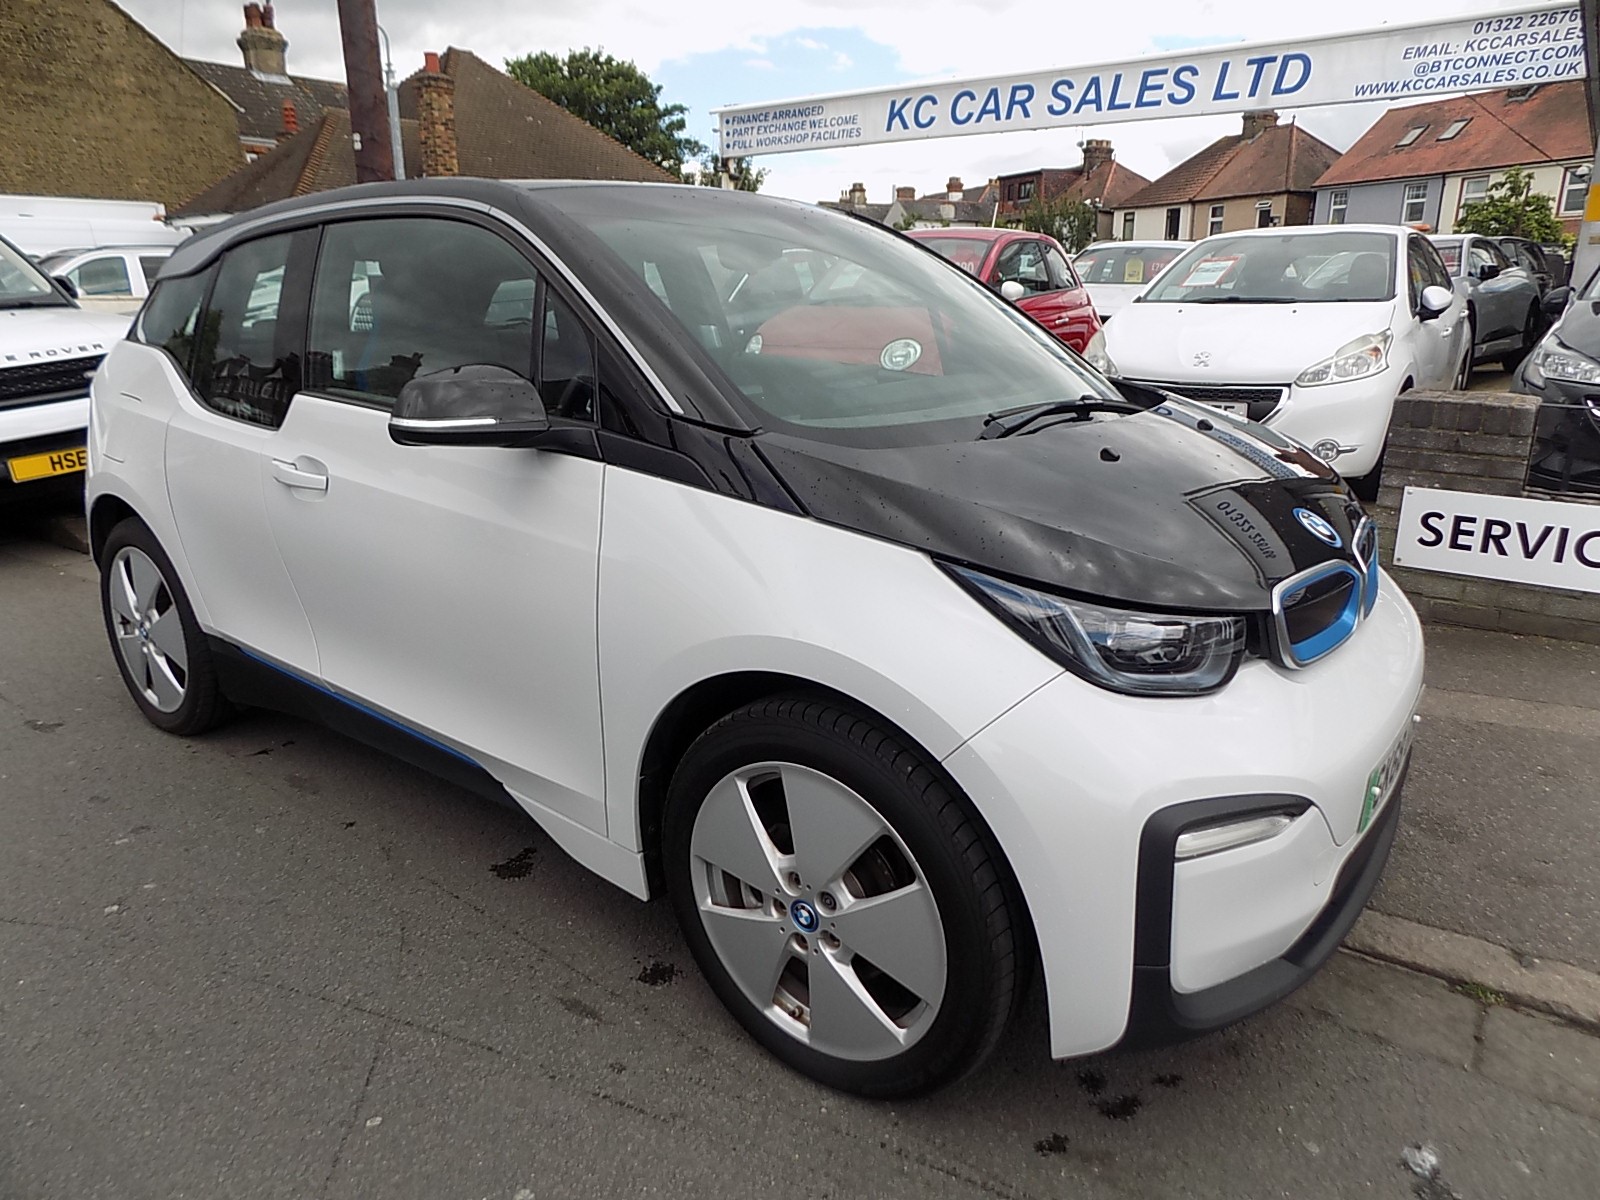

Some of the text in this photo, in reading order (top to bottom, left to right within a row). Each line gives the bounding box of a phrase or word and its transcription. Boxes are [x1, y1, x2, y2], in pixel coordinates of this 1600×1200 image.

[1473, 9, 1580, 35] 01322 22676
[1402, 43, 1459, 60] EMAIL:
[1413, 44, 1586, 77] @BTCONNECT.COM
[1354, 61, 1581, 97] WWW.KCCARSALES.CO.UK
[886, 53, 1311, 132] KC CAR SALES LTD
[731, 105, 824, 125] FINANCE ARRANGED
[732, 114, 858, 138] PART EXCHANGE WELCOME
[732, 127, 862, 150] FULL WORKSHOP FACILITIES
[29, 343, 104, 358] ROVER
[1417, 511, 1600, 568] SERVIC
